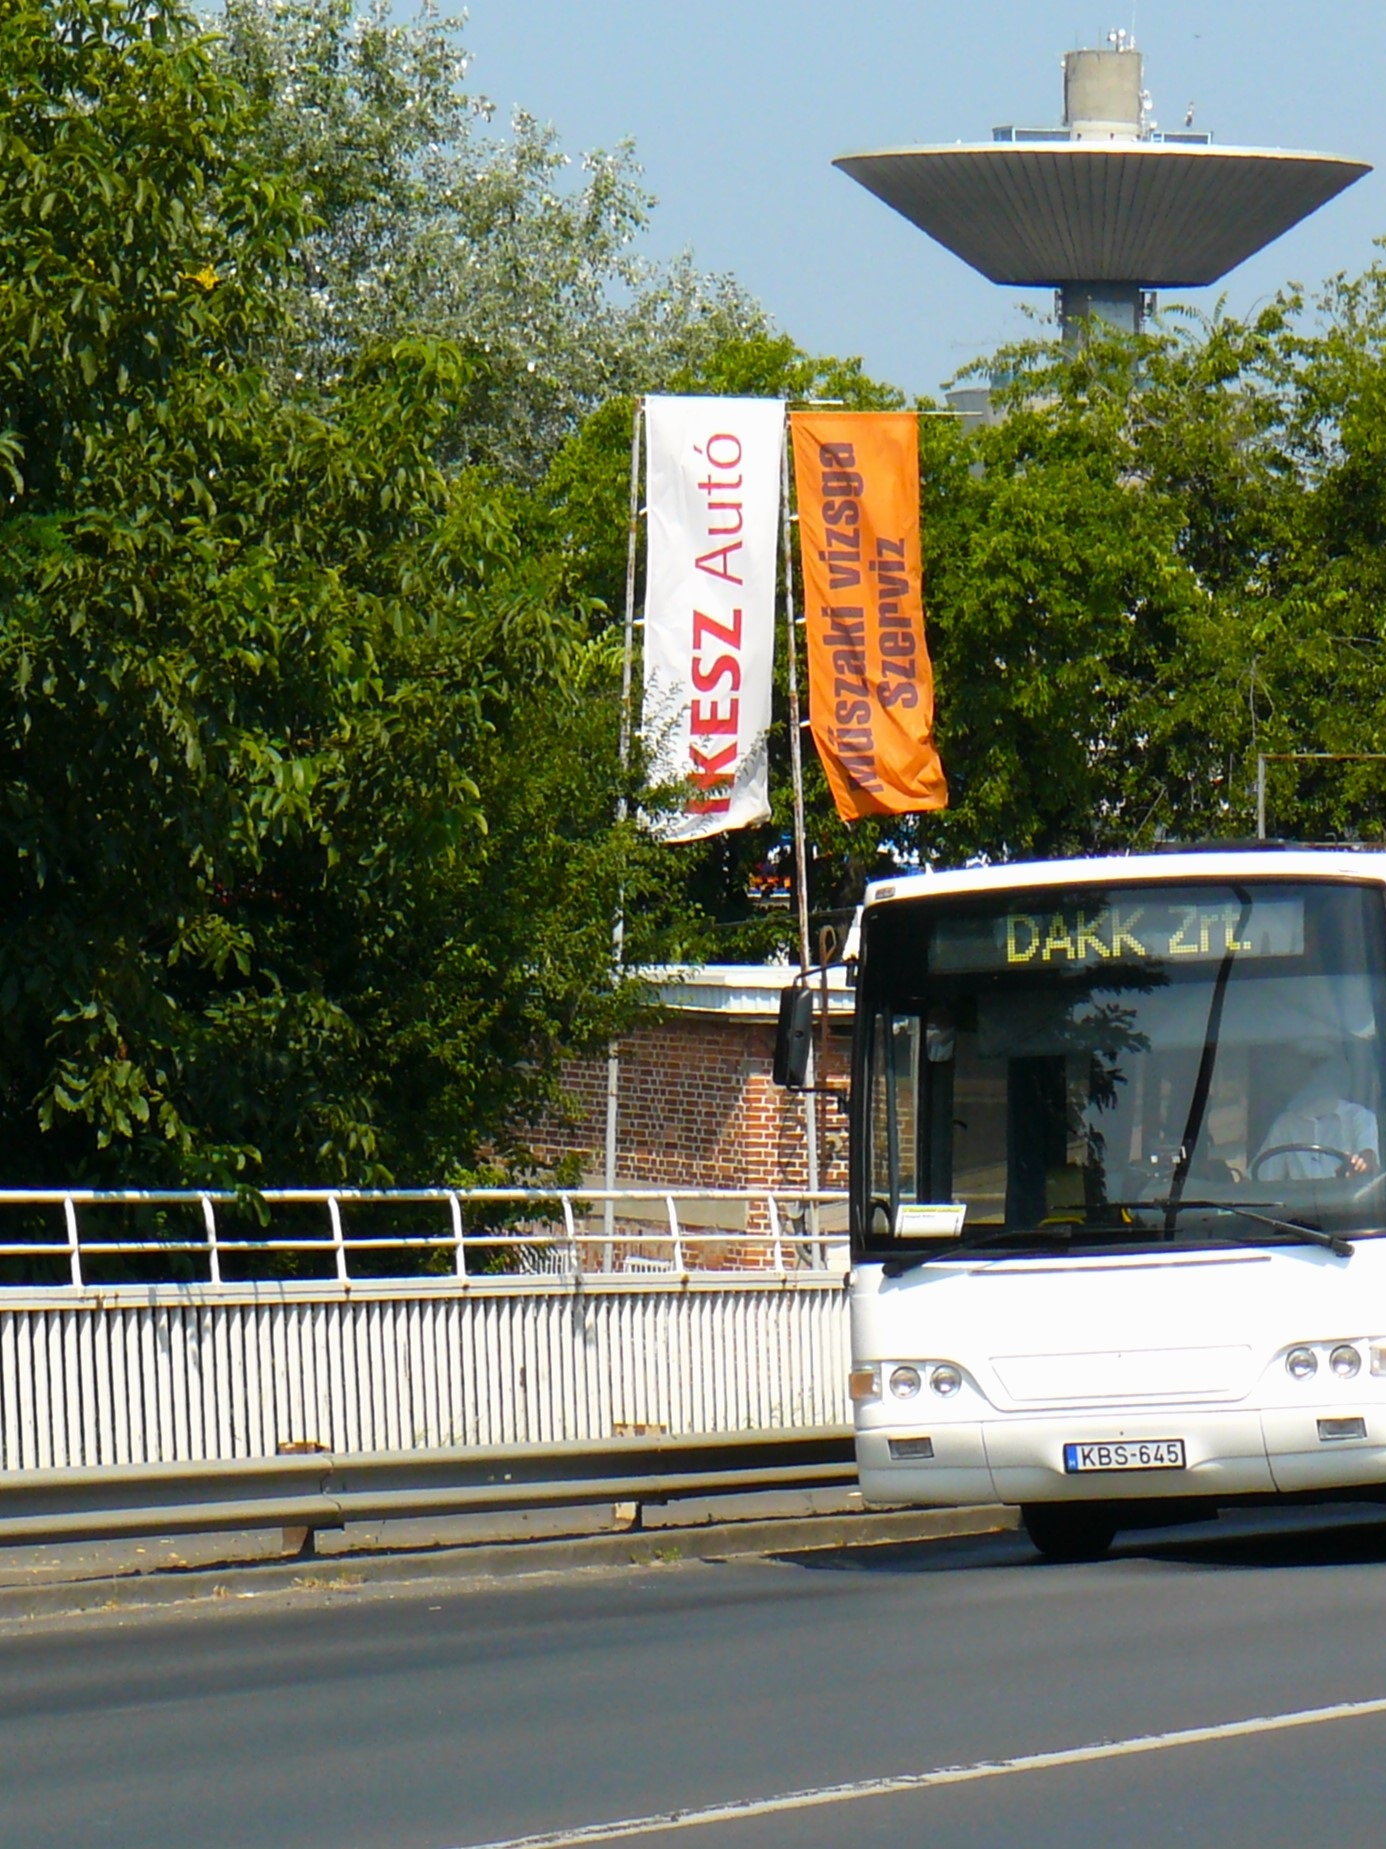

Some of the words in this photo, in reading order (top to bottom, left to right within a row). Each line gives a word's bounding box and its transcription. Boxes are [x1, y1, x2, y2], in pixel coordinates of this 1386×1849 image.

[693, 432, 743, 586] Autó
[818, 442, 865, 589] vizsga
[869, 537, 918, 709] Szerviz
[823, 607, 885, 793] Műszaki
[1007, 907, 1147, 963] DAKK
[1169, 904, 1252, 954] Zrt.
[1081, 1444, 1179, 1467] KBS-645
